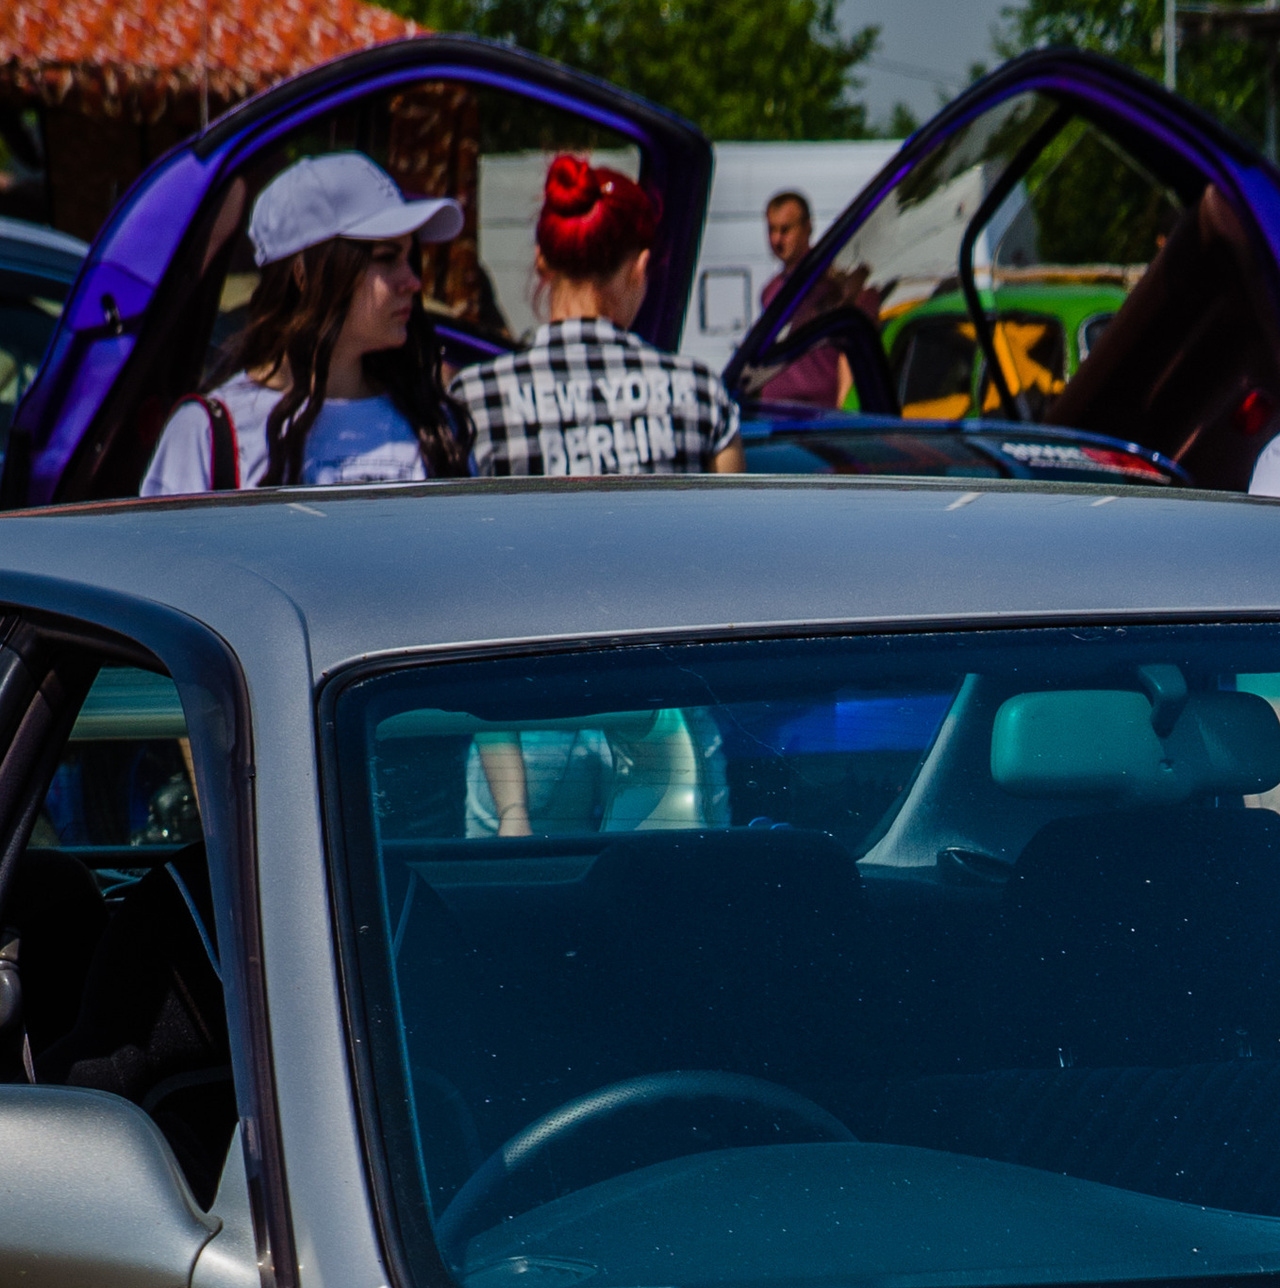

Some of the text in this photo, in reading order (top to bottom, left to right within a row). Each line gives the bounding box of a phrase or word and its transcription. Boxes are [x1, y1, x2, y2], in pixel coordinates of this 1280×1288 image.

[507, 370, 699, 424] NEW YORK
[539, 412, 677, 475] BERLIN
